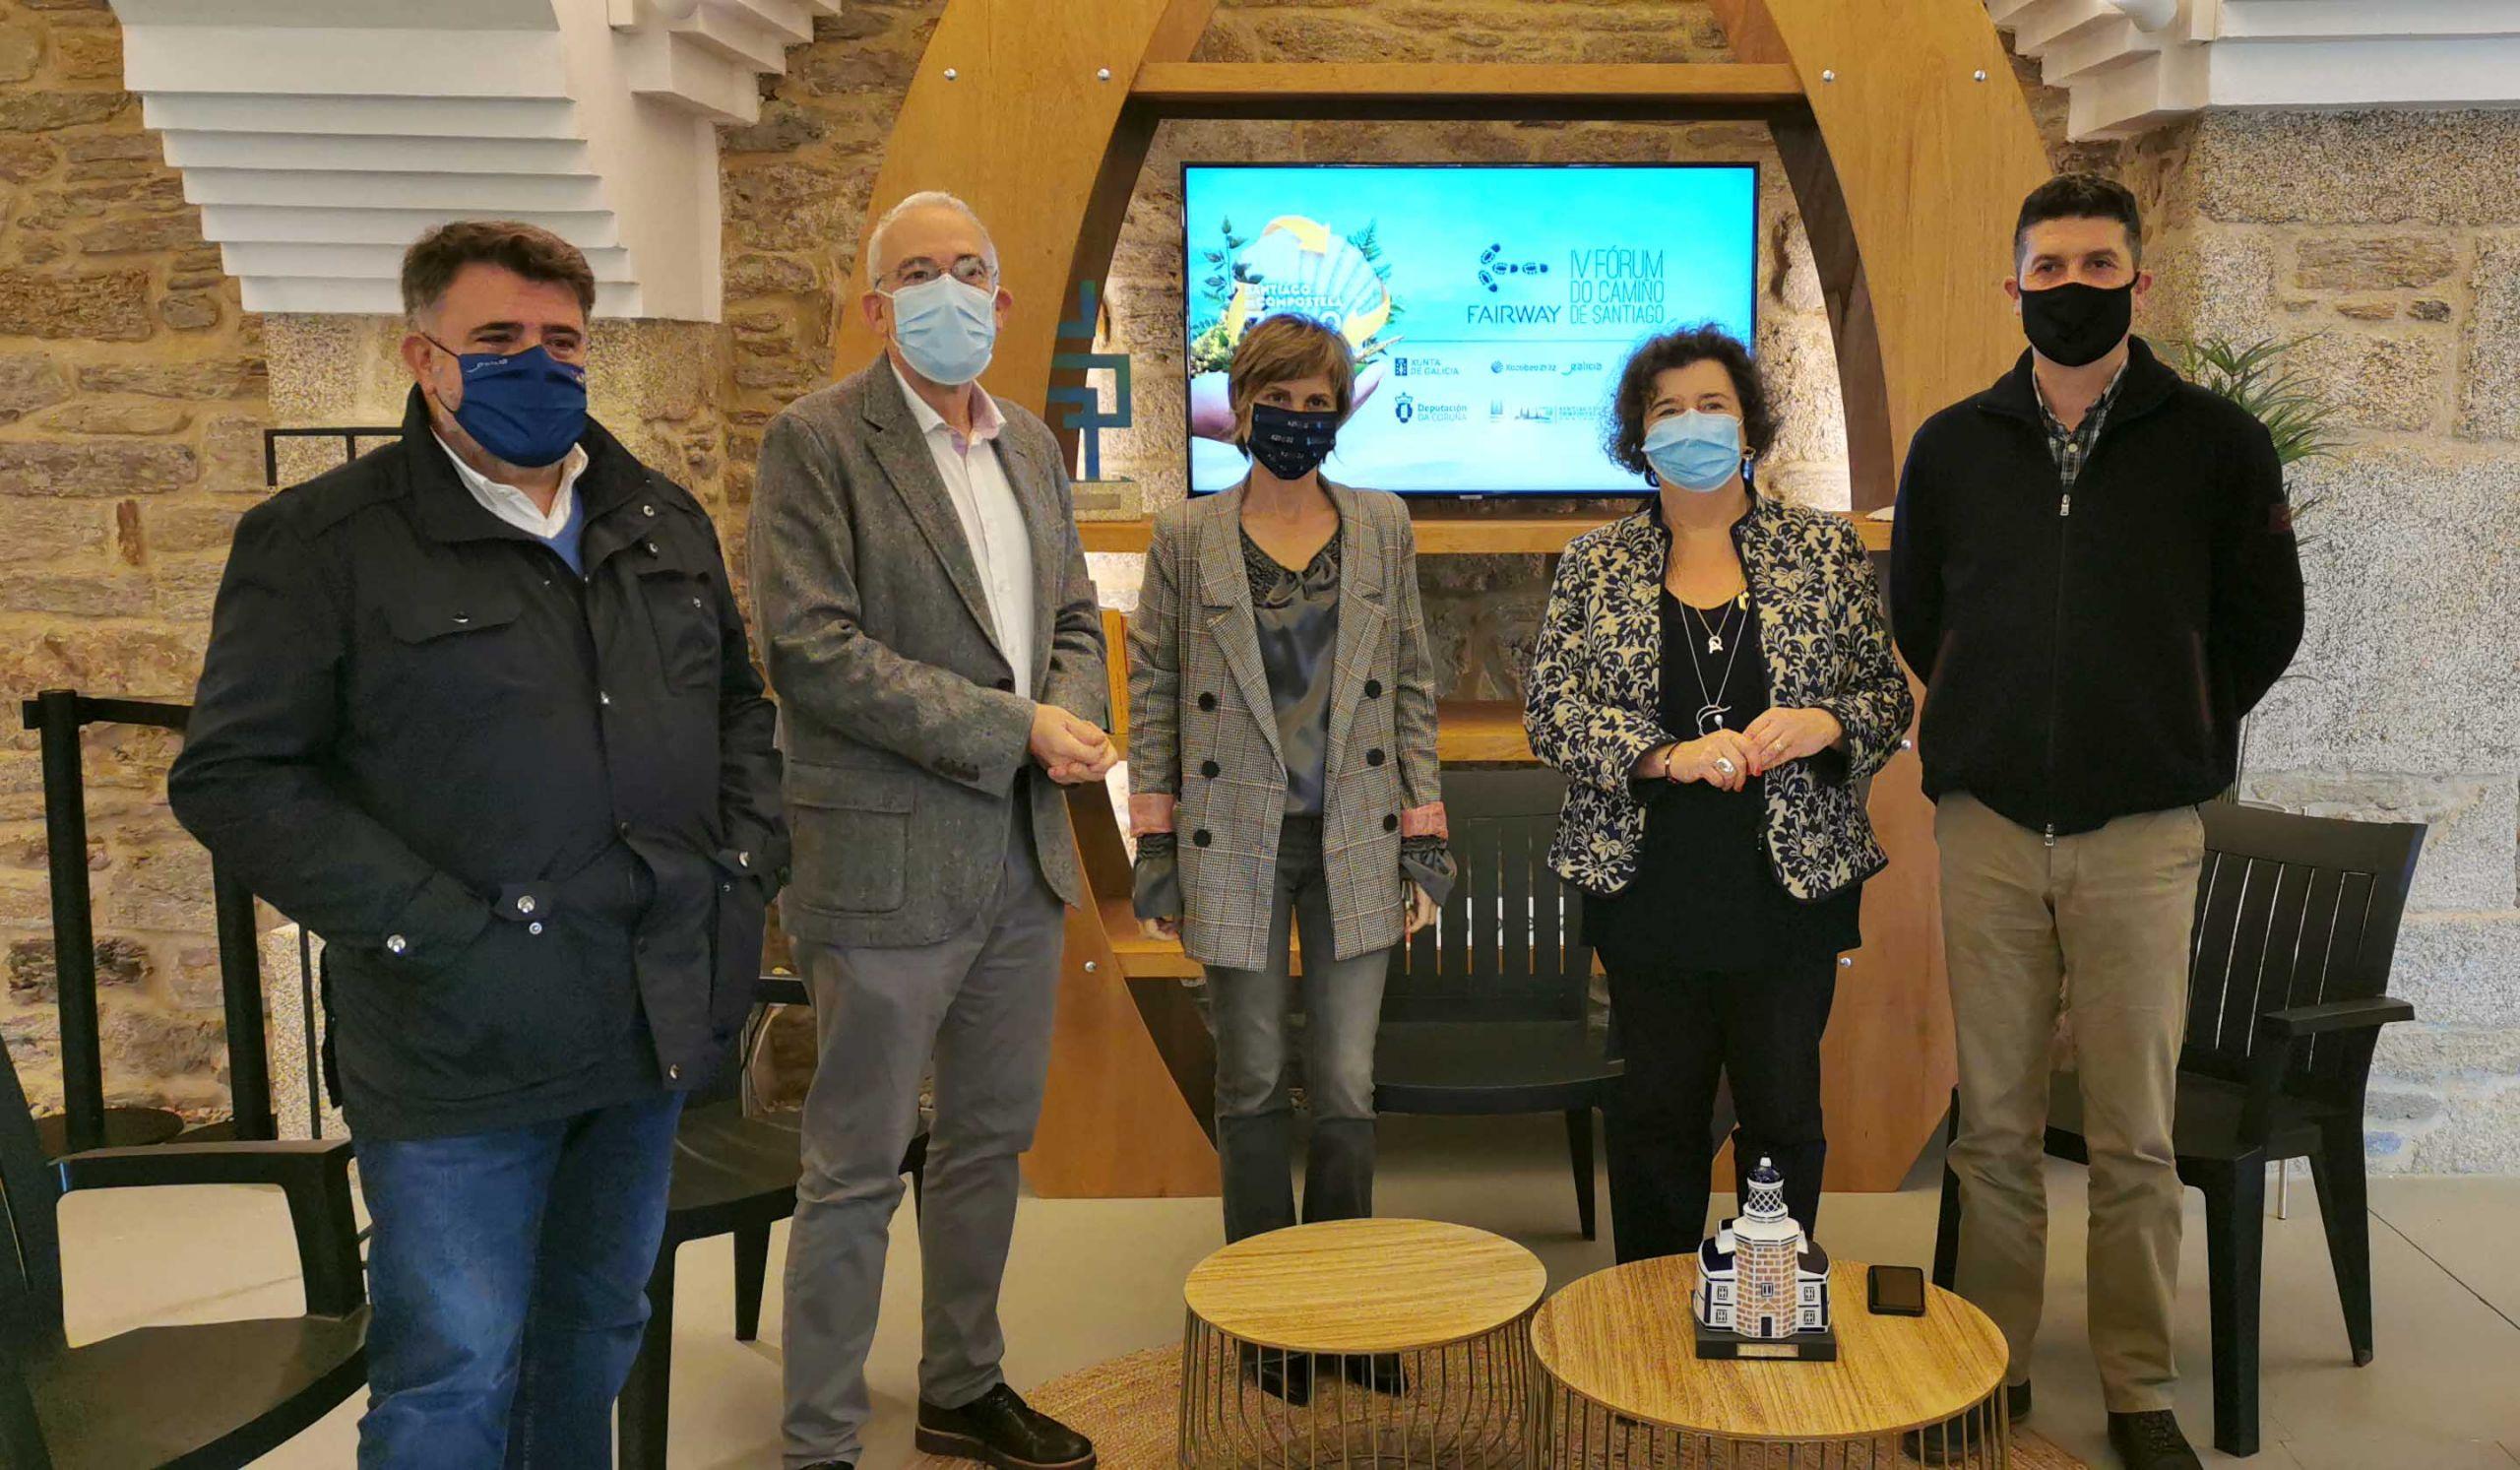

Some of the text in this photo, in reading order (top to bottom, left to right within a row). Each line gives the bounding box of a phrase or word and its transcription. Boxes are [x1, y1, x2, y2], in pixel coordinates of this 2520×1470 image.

[1570, 244, 1665, 280] IV FÓRUM
[1570, 278, 1665, 304] DO CAMIÑO
[1467, 304, 1562, 324] FAIRWAY
[1570, 304, 1665, 324] DE SANTIAGO
